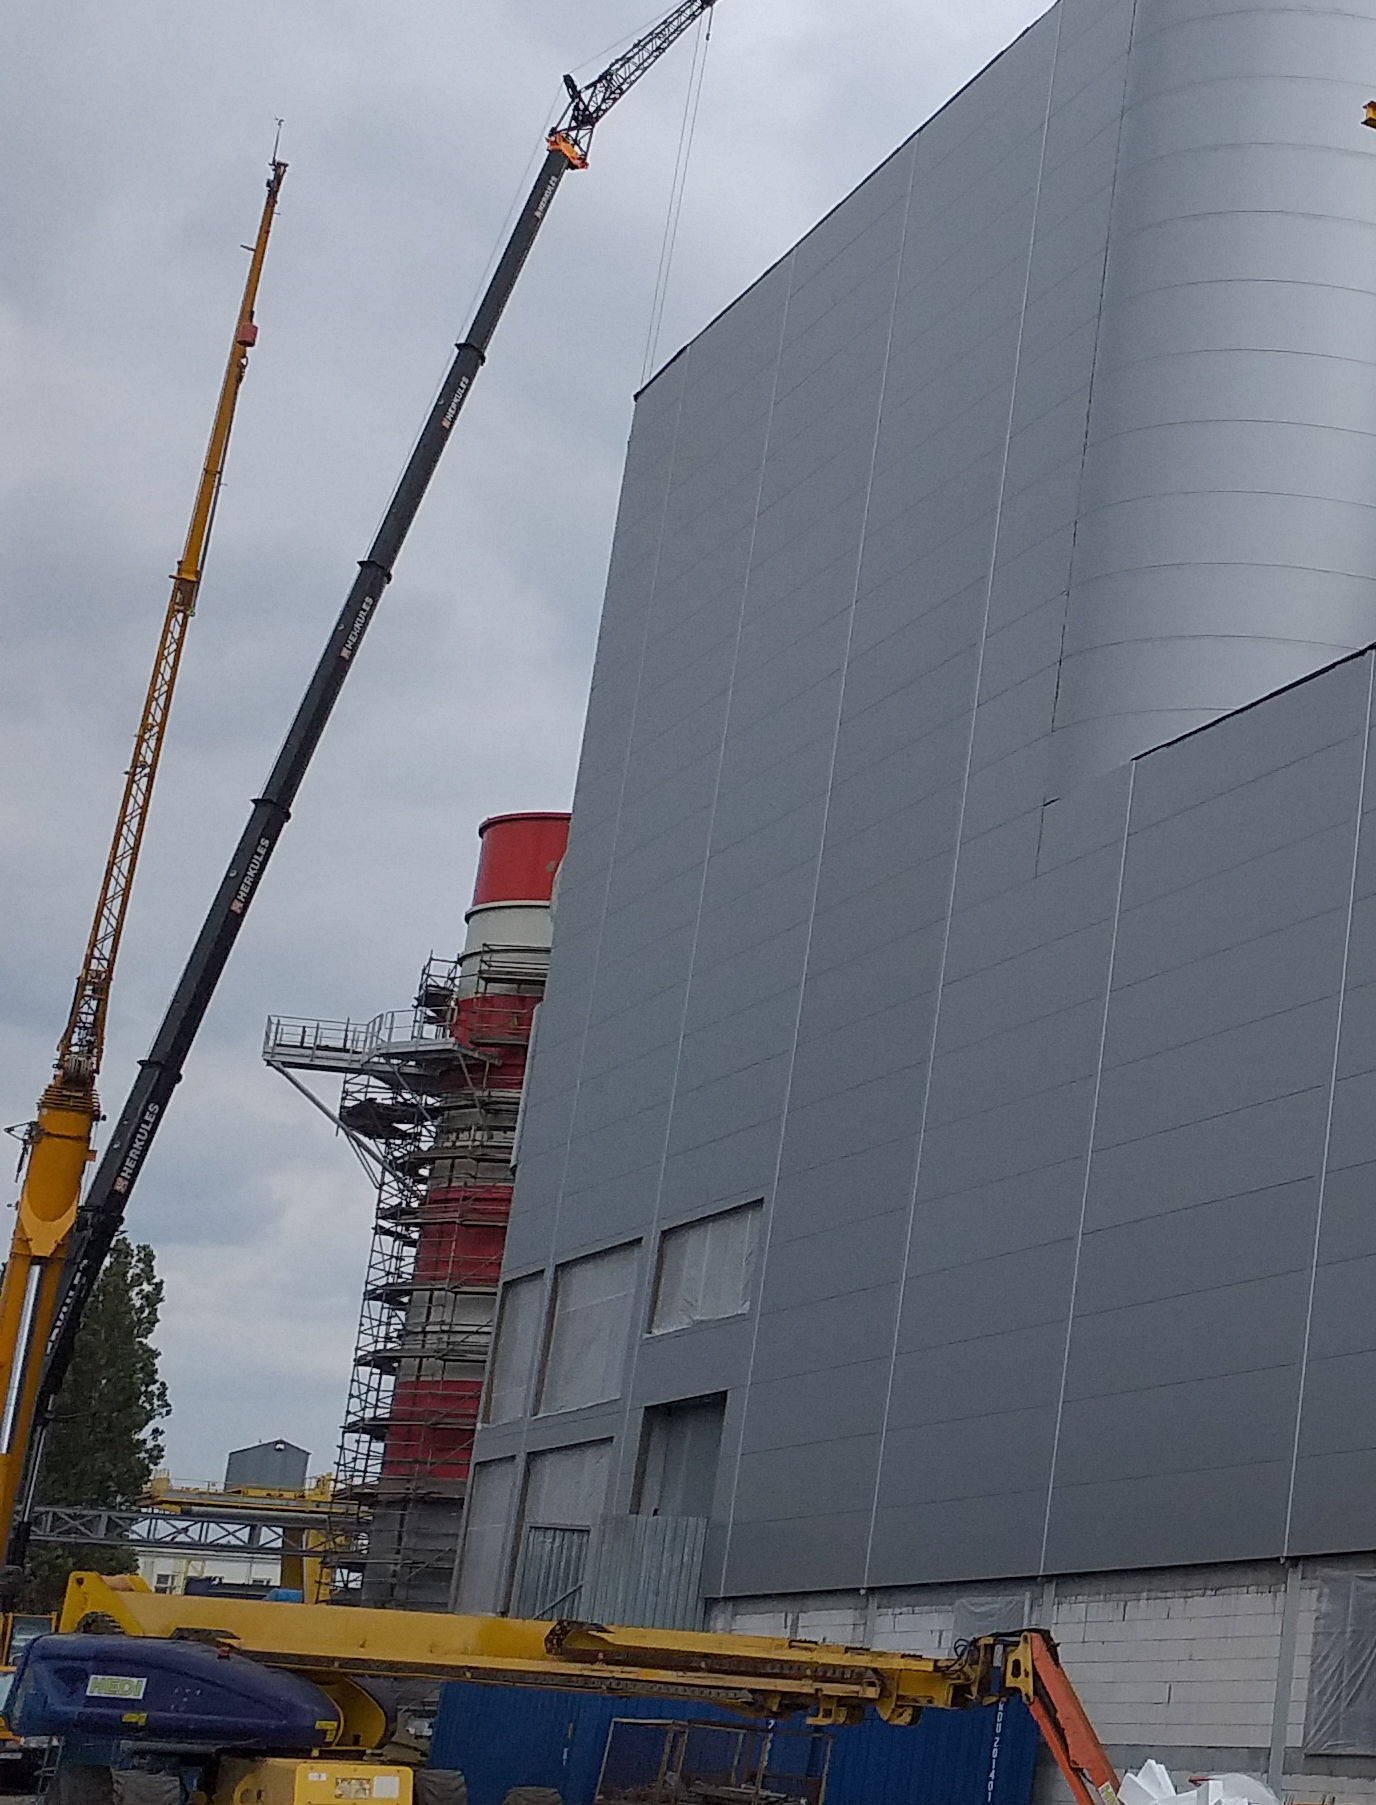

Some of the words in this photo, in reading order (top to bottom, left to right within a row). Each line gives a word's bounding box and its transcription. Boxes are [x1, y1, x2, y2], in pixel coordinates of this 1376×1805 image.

[345, 596, 374, 651] HERKULES
[237, 838, 270, 902] HERKULES
[120, 1102, 160, 1179] HERKULES
[89, 1677, 143, 1697] HEDI
